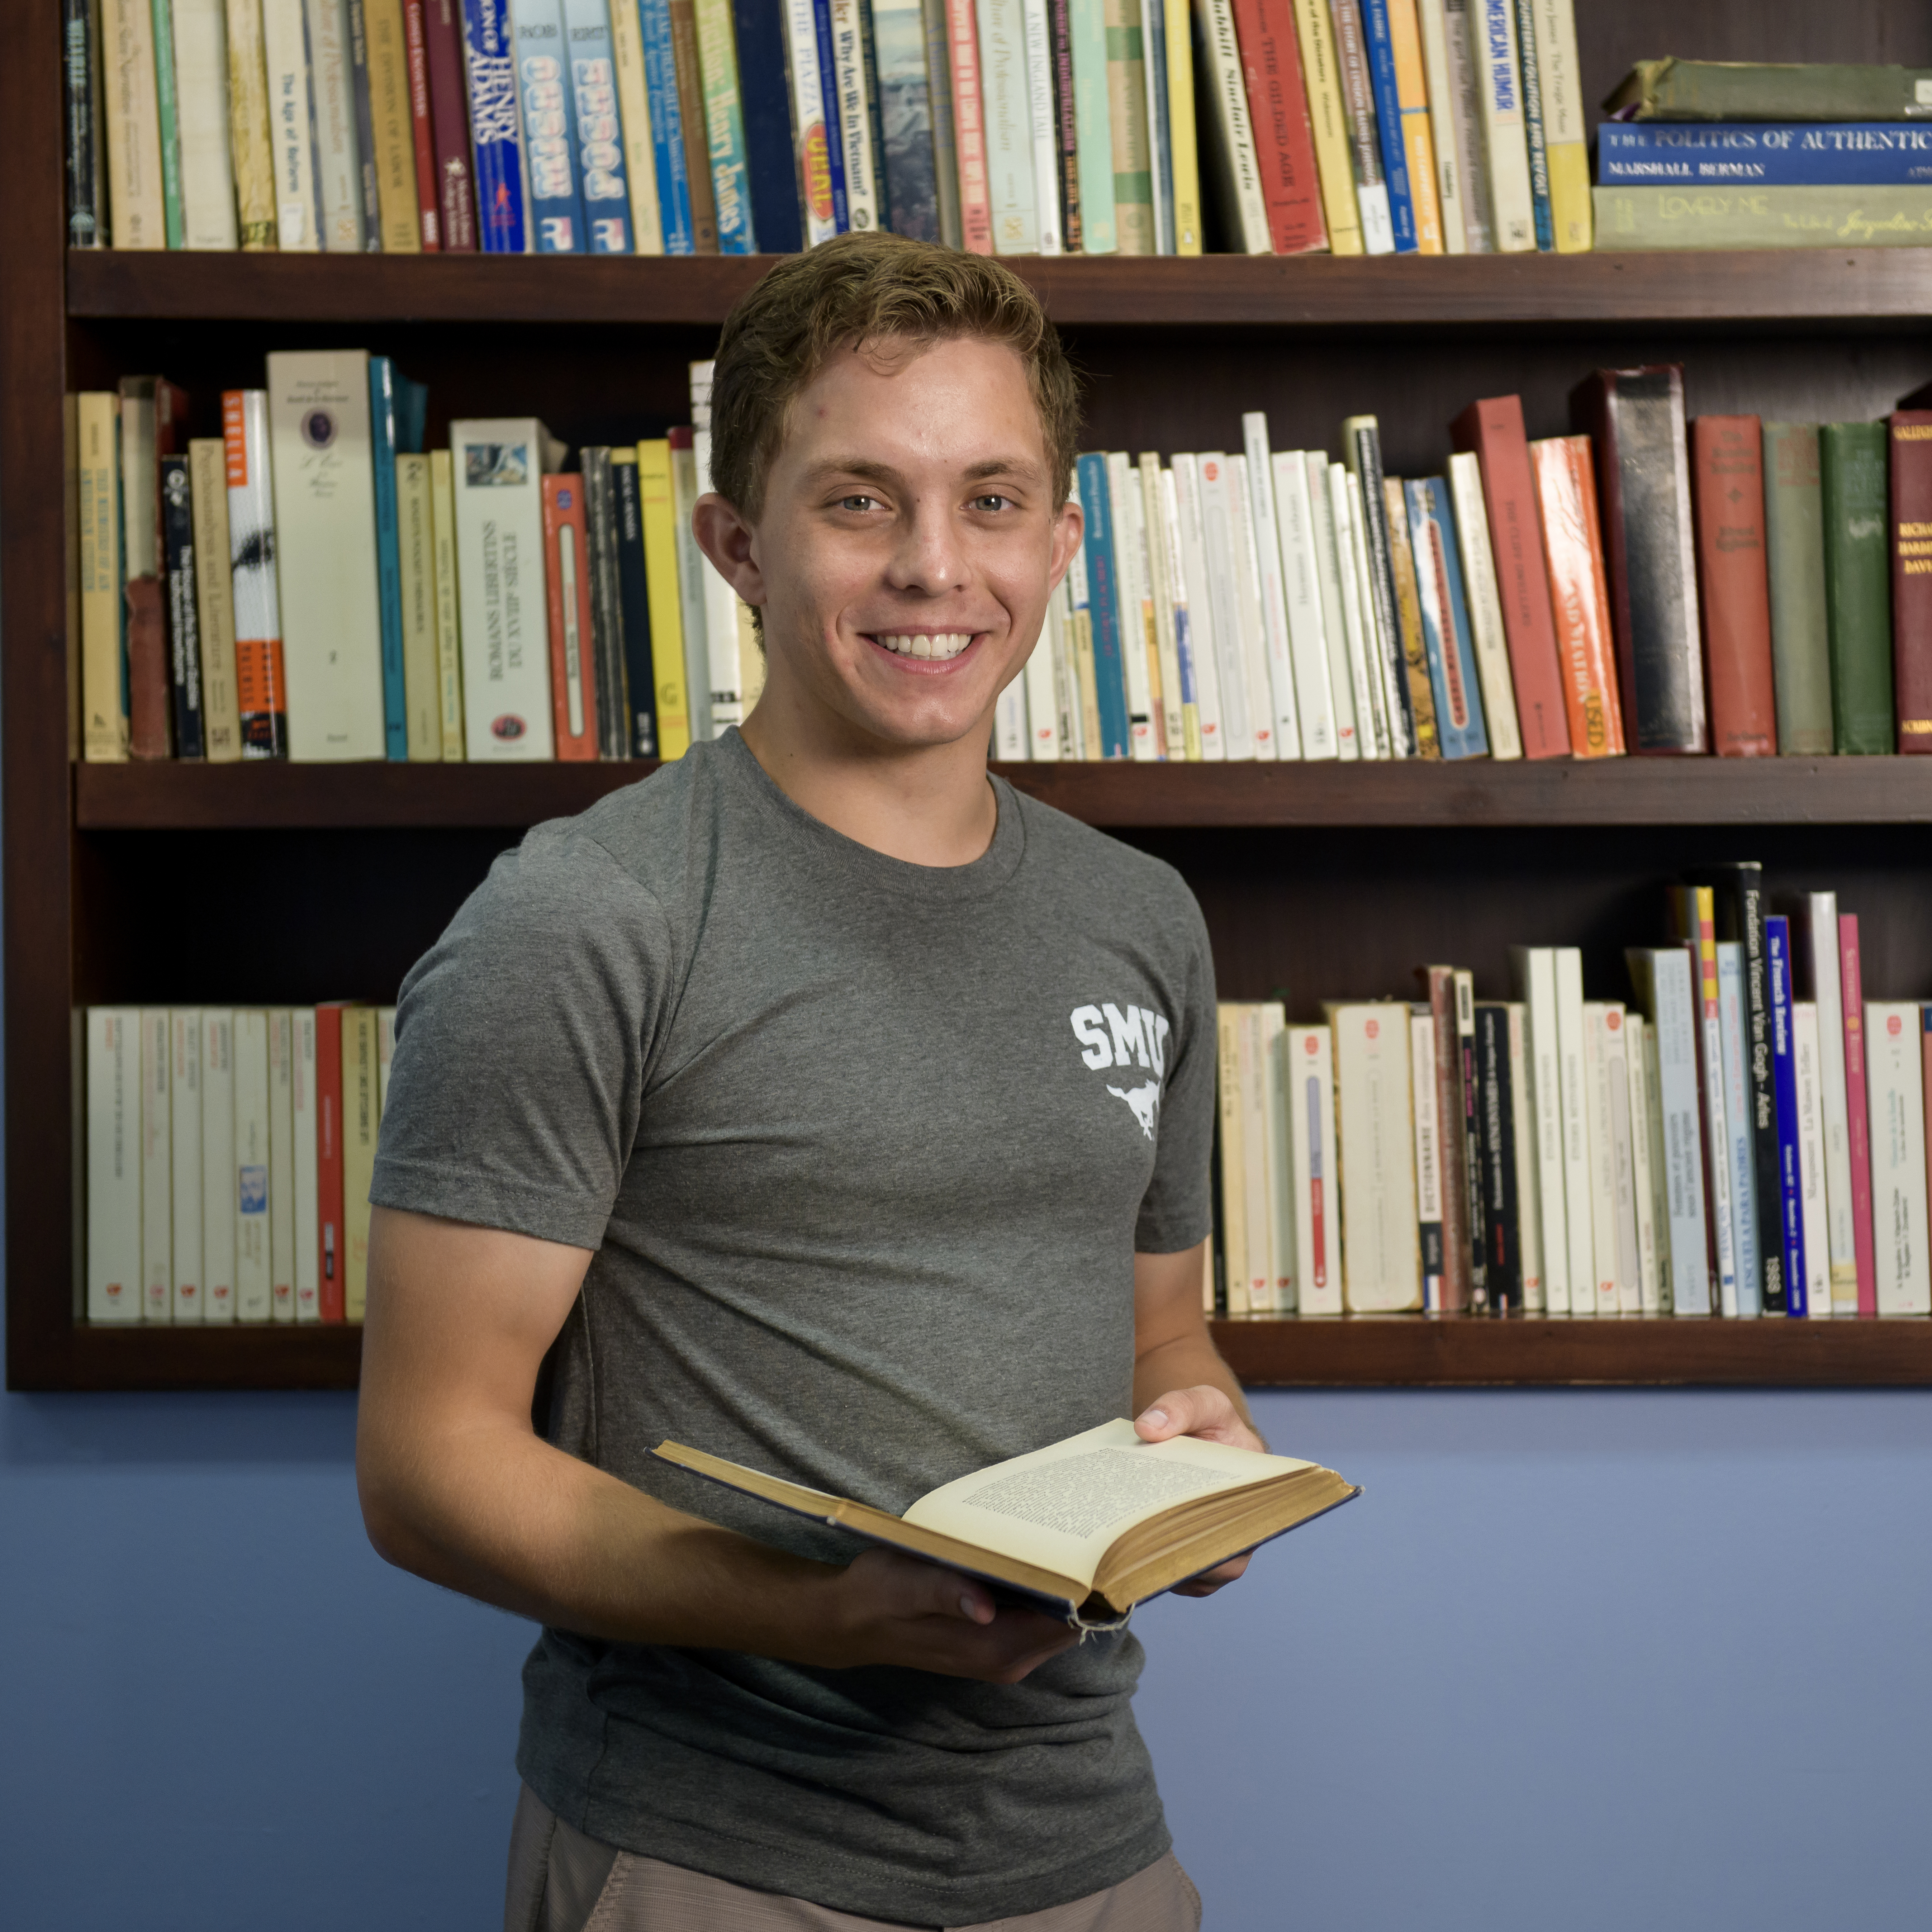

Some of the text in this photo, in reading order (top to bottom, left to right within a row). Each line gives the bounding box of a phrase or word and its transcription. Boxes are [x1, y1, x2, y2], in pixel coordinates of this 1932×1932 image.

[1030, 23, 1042, 49] NEW
[1340, 6, 1353, 23] THE
[484, 30, 499, 52] OF
[793, 1, 817, 116] THE PIAZZA
[1343, 26, 1357, 54] STORY
[1454, 40, 1467, 60] god
[377, 19, 404, 189] THE DIVISION OF LABOR
[470, 53, 495, 145] ADAMS
[490, 56, 518, 144] HENRY
[1032, 55, 1046, 111] ENGLAND
[1351, 70, 1365, 107] LYNDON
[1493, 64, 1515, 110] HUMOR
[281, 74, 300, 193] The Age of Reform
[694, 1, 745, 233] Fiction: Henry James
[837, 30, 867, 196] Why Are We In Vietnam?
[1035, 115, 1049, 139] TALE
[1225, 68, 1254, 190] Sinclair Lewis
[1261, 37, 1295, 186] THE GILDED AGE
[1532, 123, 1545, 148] AND
[1609, 133, 1647, 147] THE
[1655, 130, 1757, 148] POLITICS
[1762, 130, 1795, 149] OF
[1533, 152, 1548, 196] REVOLT
[1609, 161, 1765, 176] MARSHALL BERMAN
[1658, 194, 1768, 219] LOVELY ME
[181, 545, 193, 565] The
[199, 445, 226, 670] Psychoanalysis and Literature
[1504, 501, 1531, 627] THE CLIFF DWELLERS
[182, 568, 194, 600] House
[183, 602, 195, 612] of
[482, 521, 503, 680] ROMANS LIBERTINS
[170, 570, 185, 685] Nathaniel Hawthorne
[184, 614, 196, 633] the
[185, 636, 197, 664] Seven
[508, 647, 523, 668] DU
[1585, 695, 1605, 748] USED
[1745, 889, 1772, 1129] Fondation Vincent Van Gogh Arles
[1770, 937, 1787, 1055] The French Review
[1845, 948, 1861, 1074] SOUTHWEST REVIEW
[1069, 1002, 1169, 1076] SMU
[1799, 1042, 1820, 1201] Maupassant La Maison Tellier
[1421, 1126, 1436, 1213] DICTIONNAIRE
[1673, 1174, 1683, 1218] Femmes
[1687, 1196, 1696, 1219] sous
[1736, 1137, 1755, 1290] ESCUELA PARA PADRES
[1764, 1255, 1781, 1294] 1988
